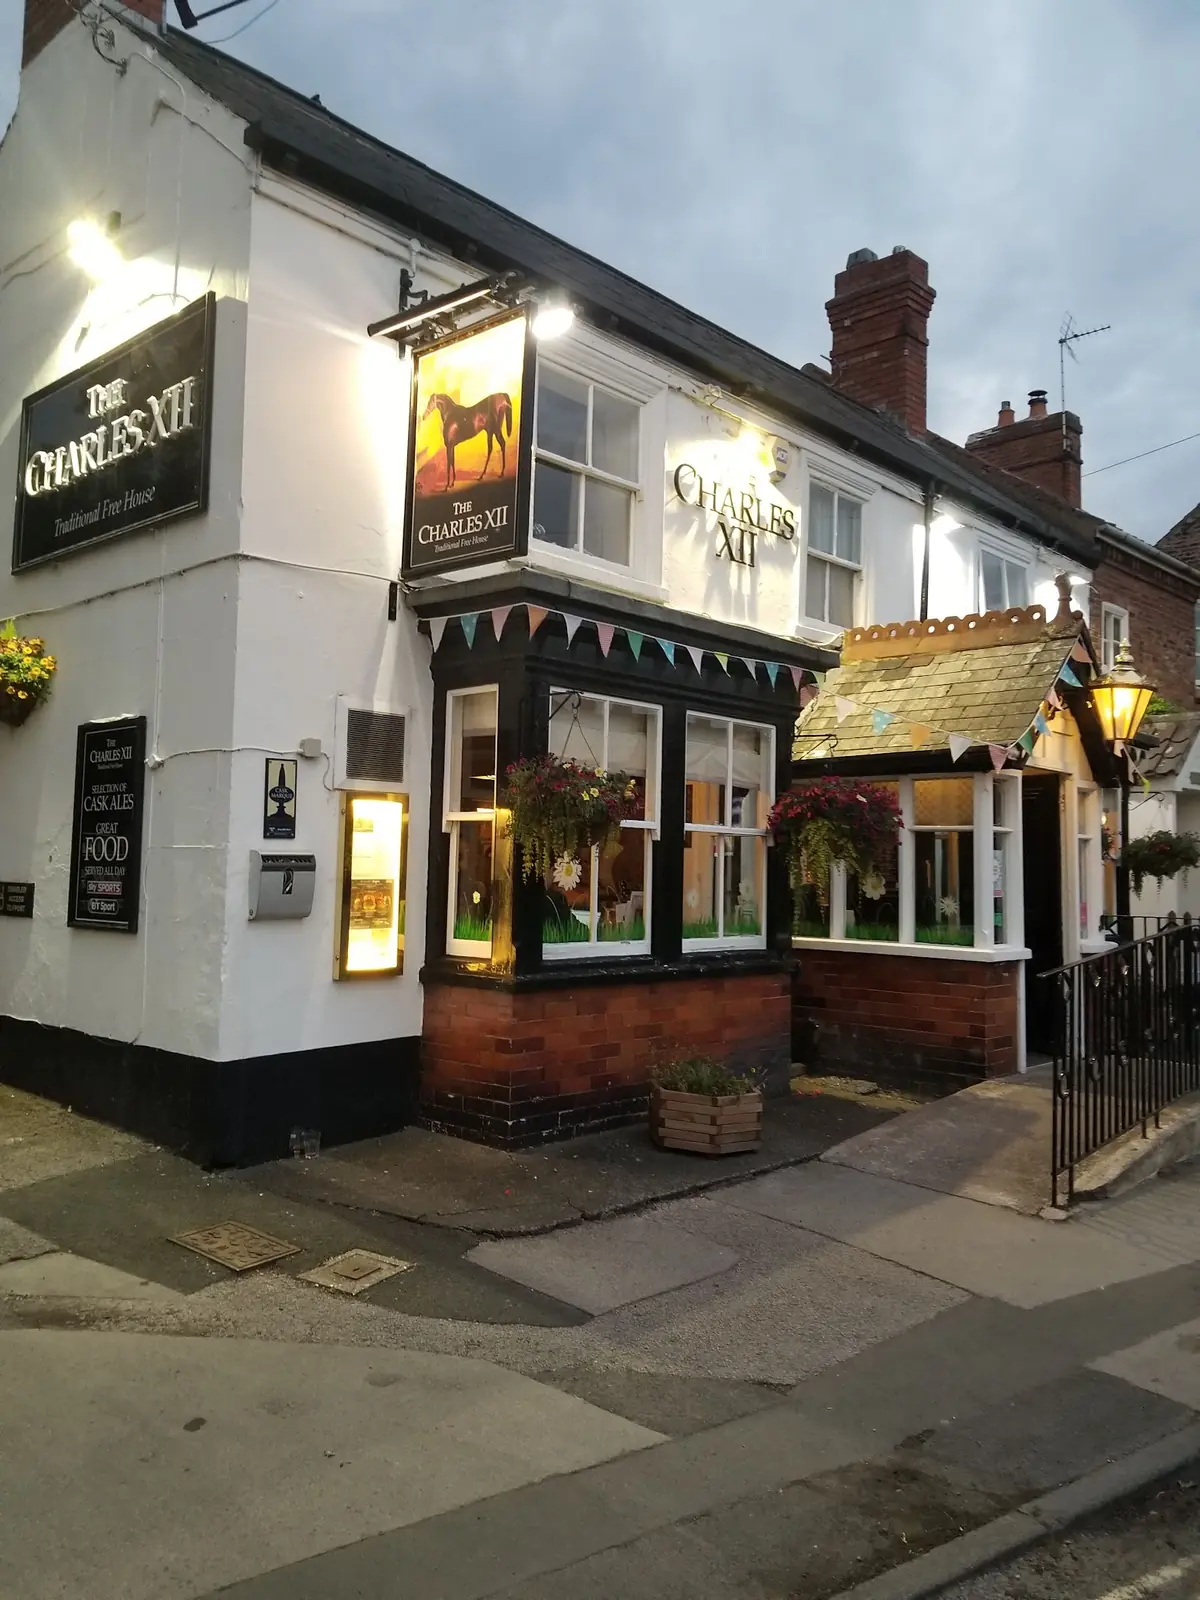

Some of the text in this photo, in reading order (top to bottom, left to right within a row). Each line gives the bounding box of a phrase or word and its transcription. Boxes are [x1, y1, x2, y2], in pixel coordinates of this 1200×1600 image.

[87, 378, 128, 418] THE
[25, 376, 196, 496] CHARLES XII
[54, 486, 156, 538] Traditional Free House
[453, 501, 473, 516] THE
[674, 463, 795, 540] CHARLES
[418, 505, 508, 545] CHARLES XII
[716, 520, 758, 568] XII
[89, 746, 133, 763] CHARLES XII
[84, 793, 134, 812] CASK ALES
[95, 822, 119, 834] GREAT
[84, 836, 129, 862] FOOD
[100, 901, 116, 913] Sport
